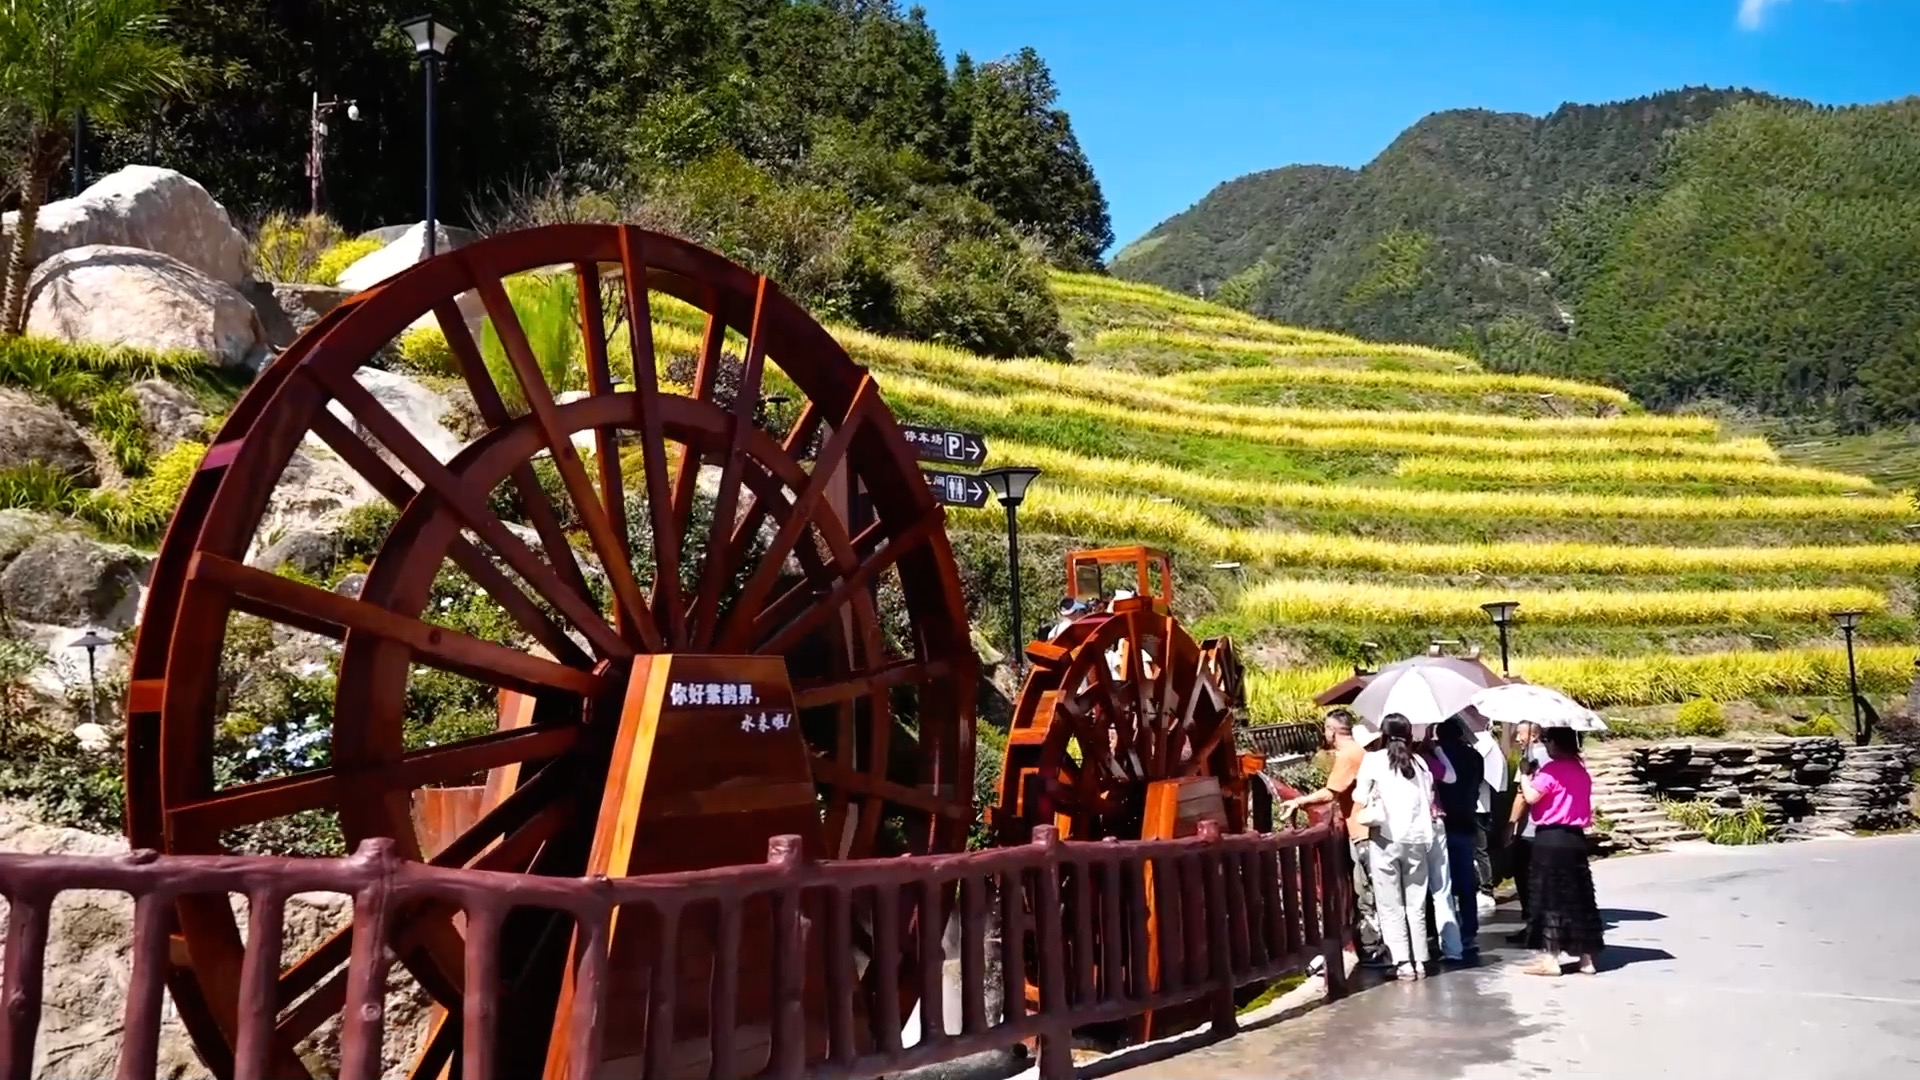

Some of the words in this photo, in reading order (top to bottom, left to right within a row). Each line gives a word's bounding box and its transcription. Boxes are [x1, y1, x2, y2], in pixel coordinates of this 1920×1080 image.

[904, 430, 943, 445] 停车场
[948, 436, 960, 455] P
